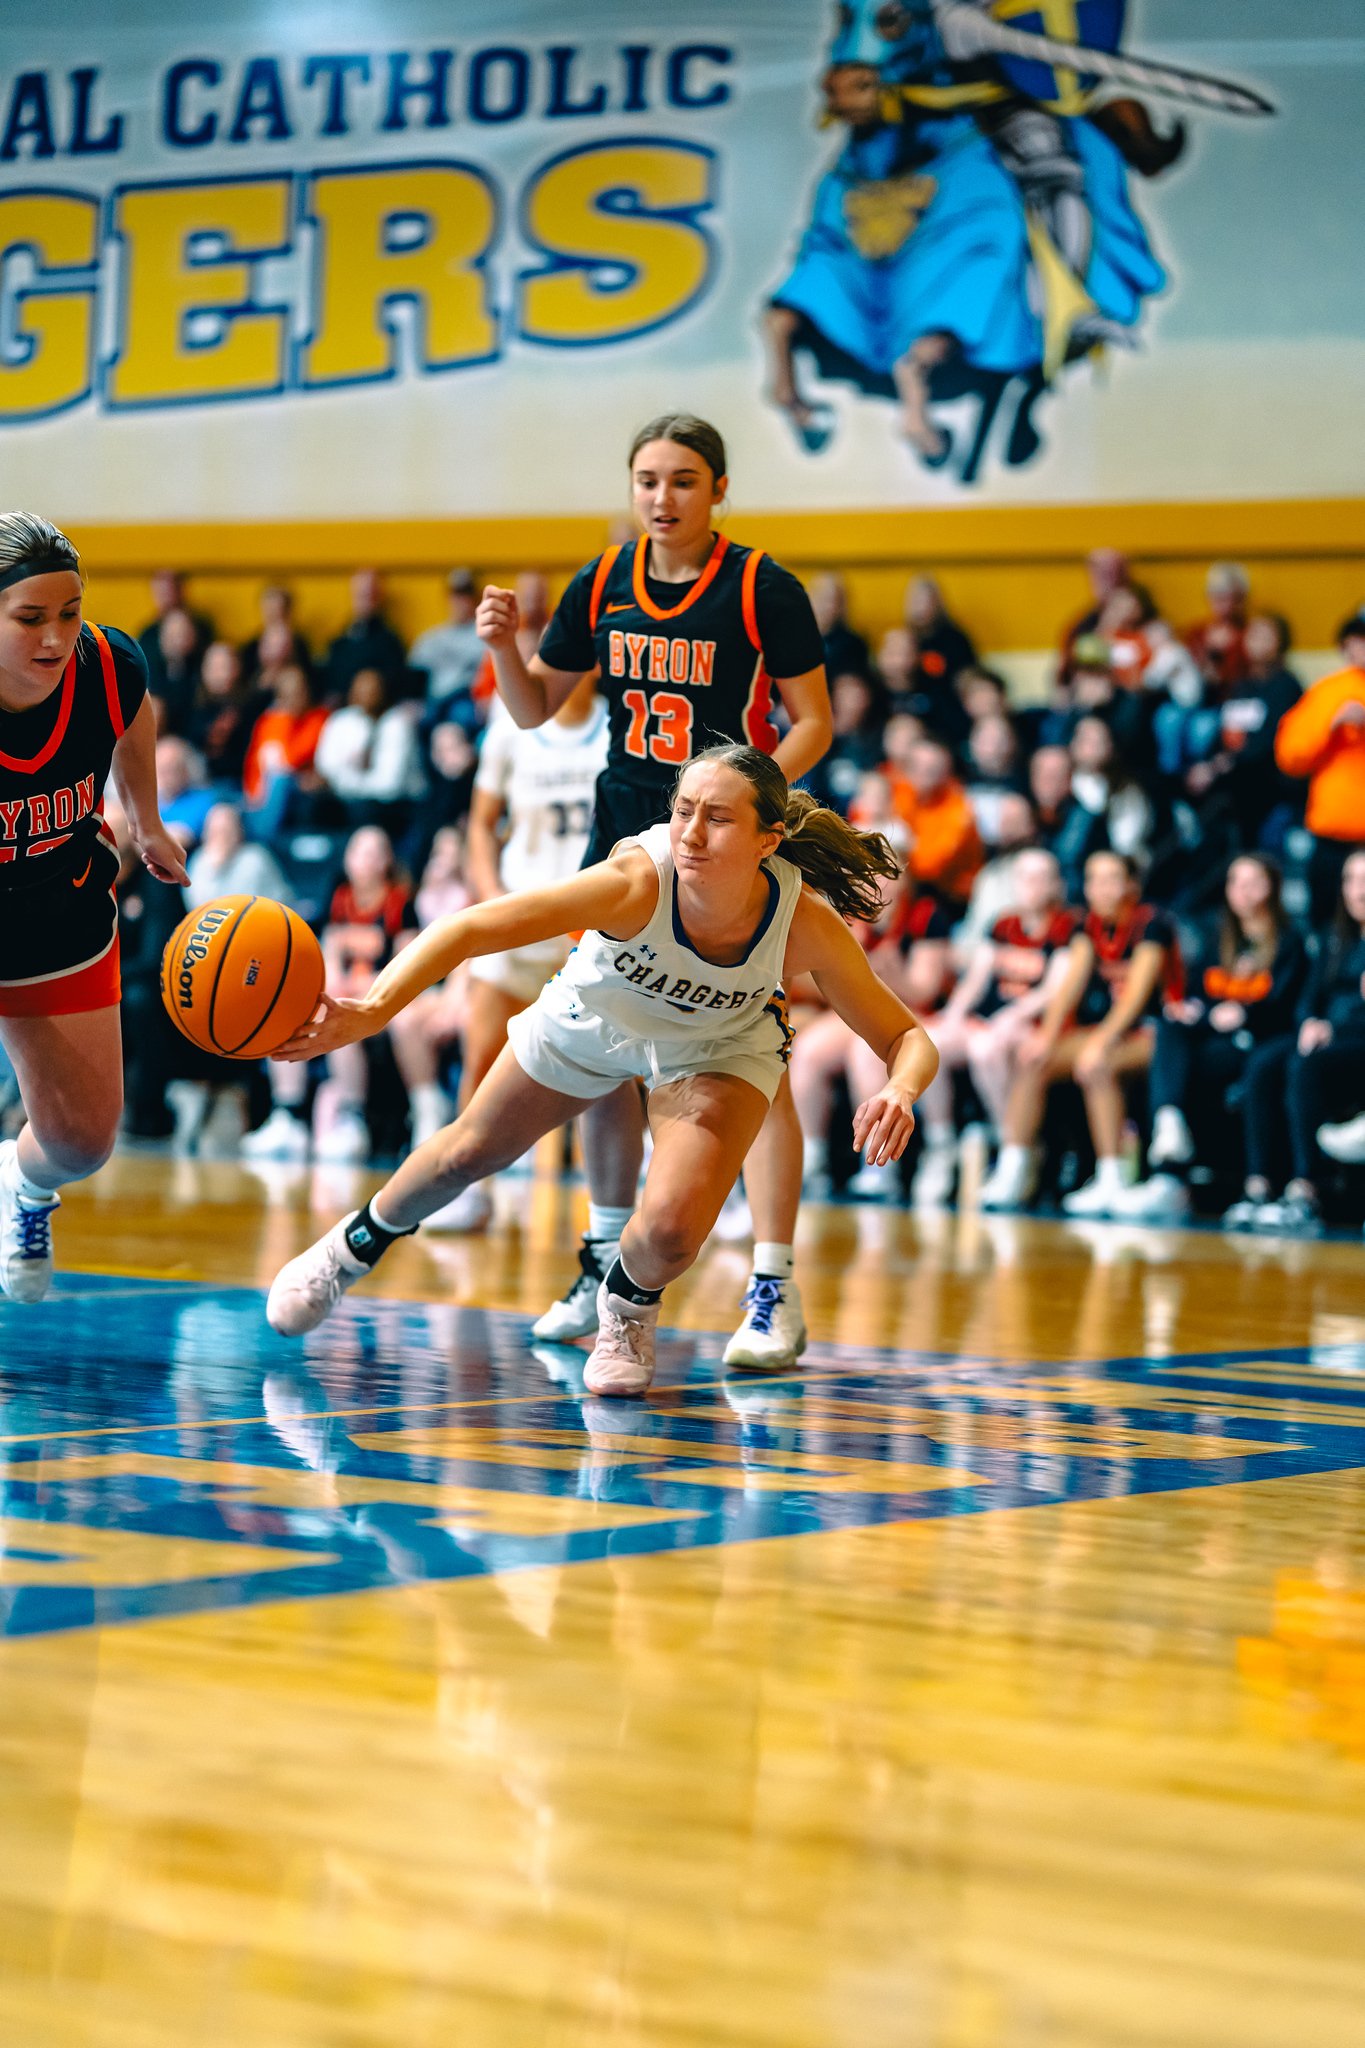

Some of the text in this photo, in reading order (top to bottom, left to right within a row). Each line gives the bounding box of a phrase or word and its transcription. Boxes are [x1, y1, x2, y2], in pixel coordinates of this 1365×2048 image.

[163, 45, 733, 148] CATHOLIC
[0, 137, 720, 424] GERS
[609, 630, 716, 686] BYRON
[622, 689, 694, 765] 13
[179, 907, 235, 1009] Wilson
